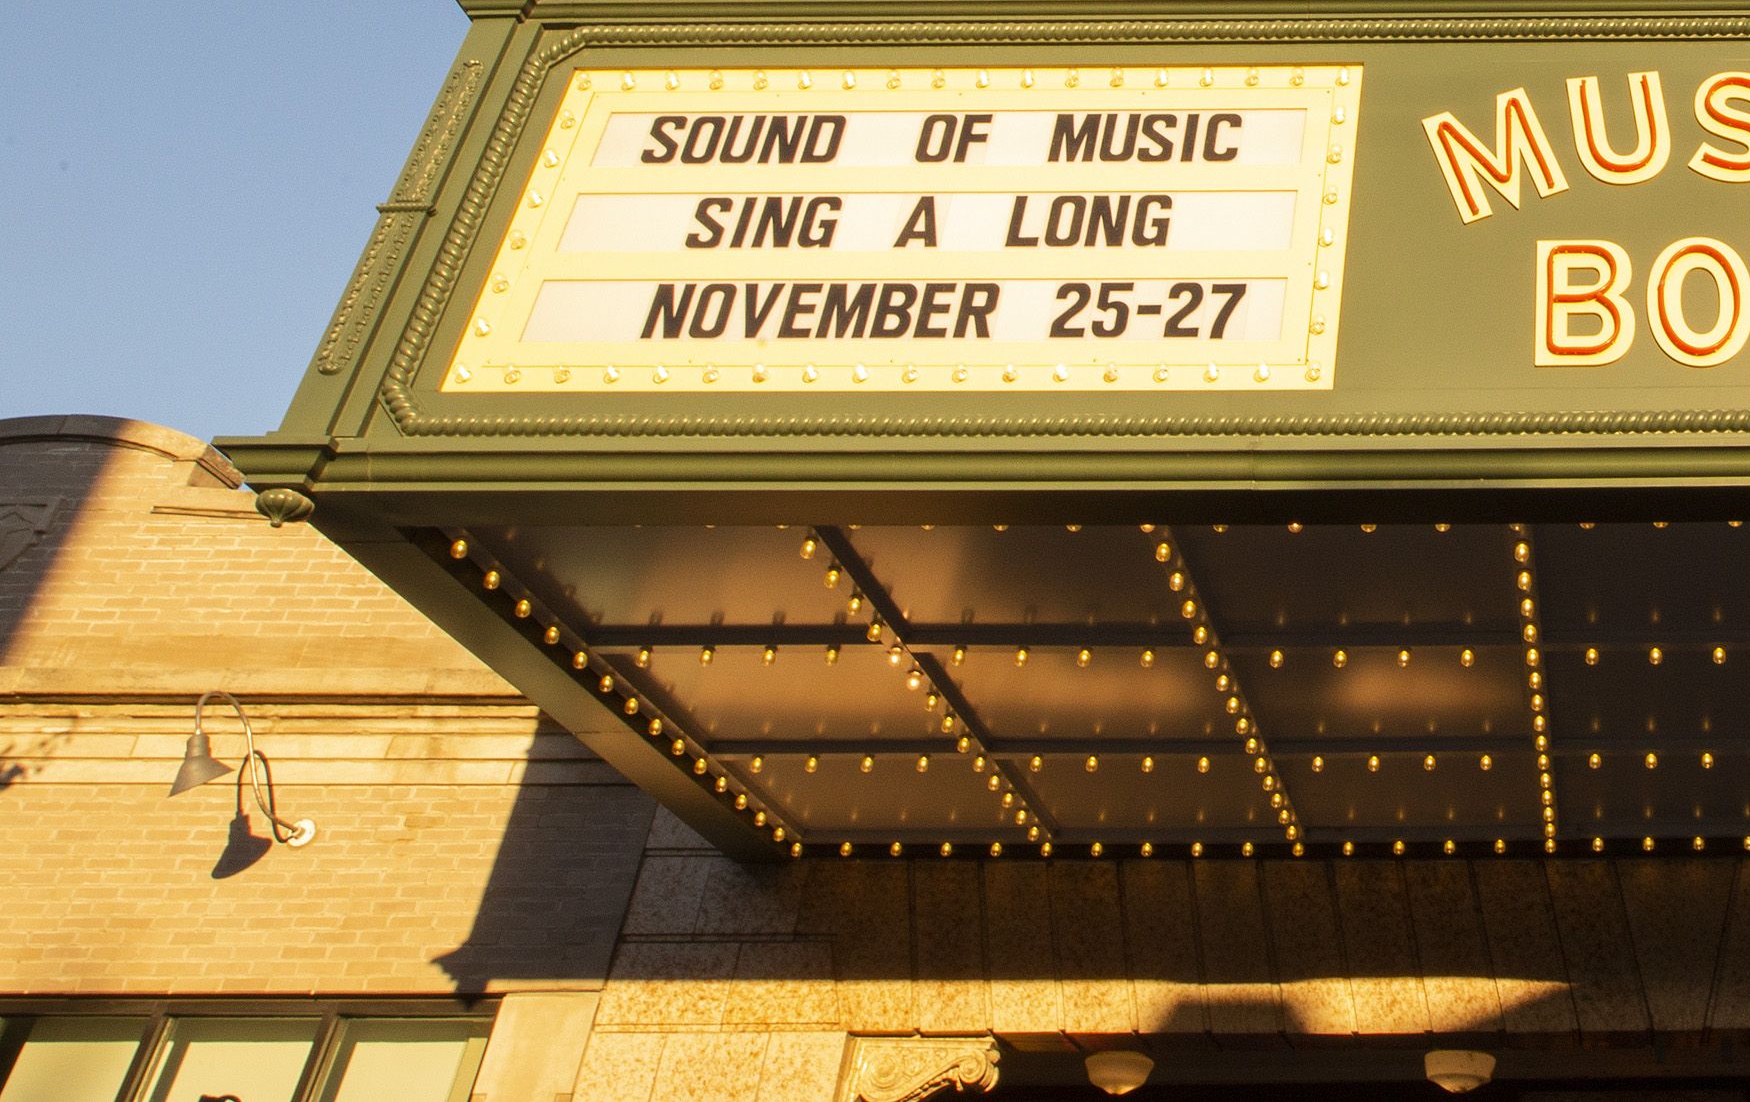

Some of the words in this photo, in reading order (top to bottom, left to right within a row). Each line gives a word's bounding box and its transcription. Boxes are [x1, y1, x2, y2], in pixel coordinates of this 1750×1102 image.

[640, 113, 847, 164] SOUND
[914, 113, 993, 163] OF
[1048, 113, 1244, 163] MUSIC
[684, 195, 844, 250] SING
[894, 195, 938, 248] A
[1004, 194, 1174, 248] LONG
[640, 282, 1001, 340] NOVEMBER
[1049, 282, 1248, 340] 25-27
